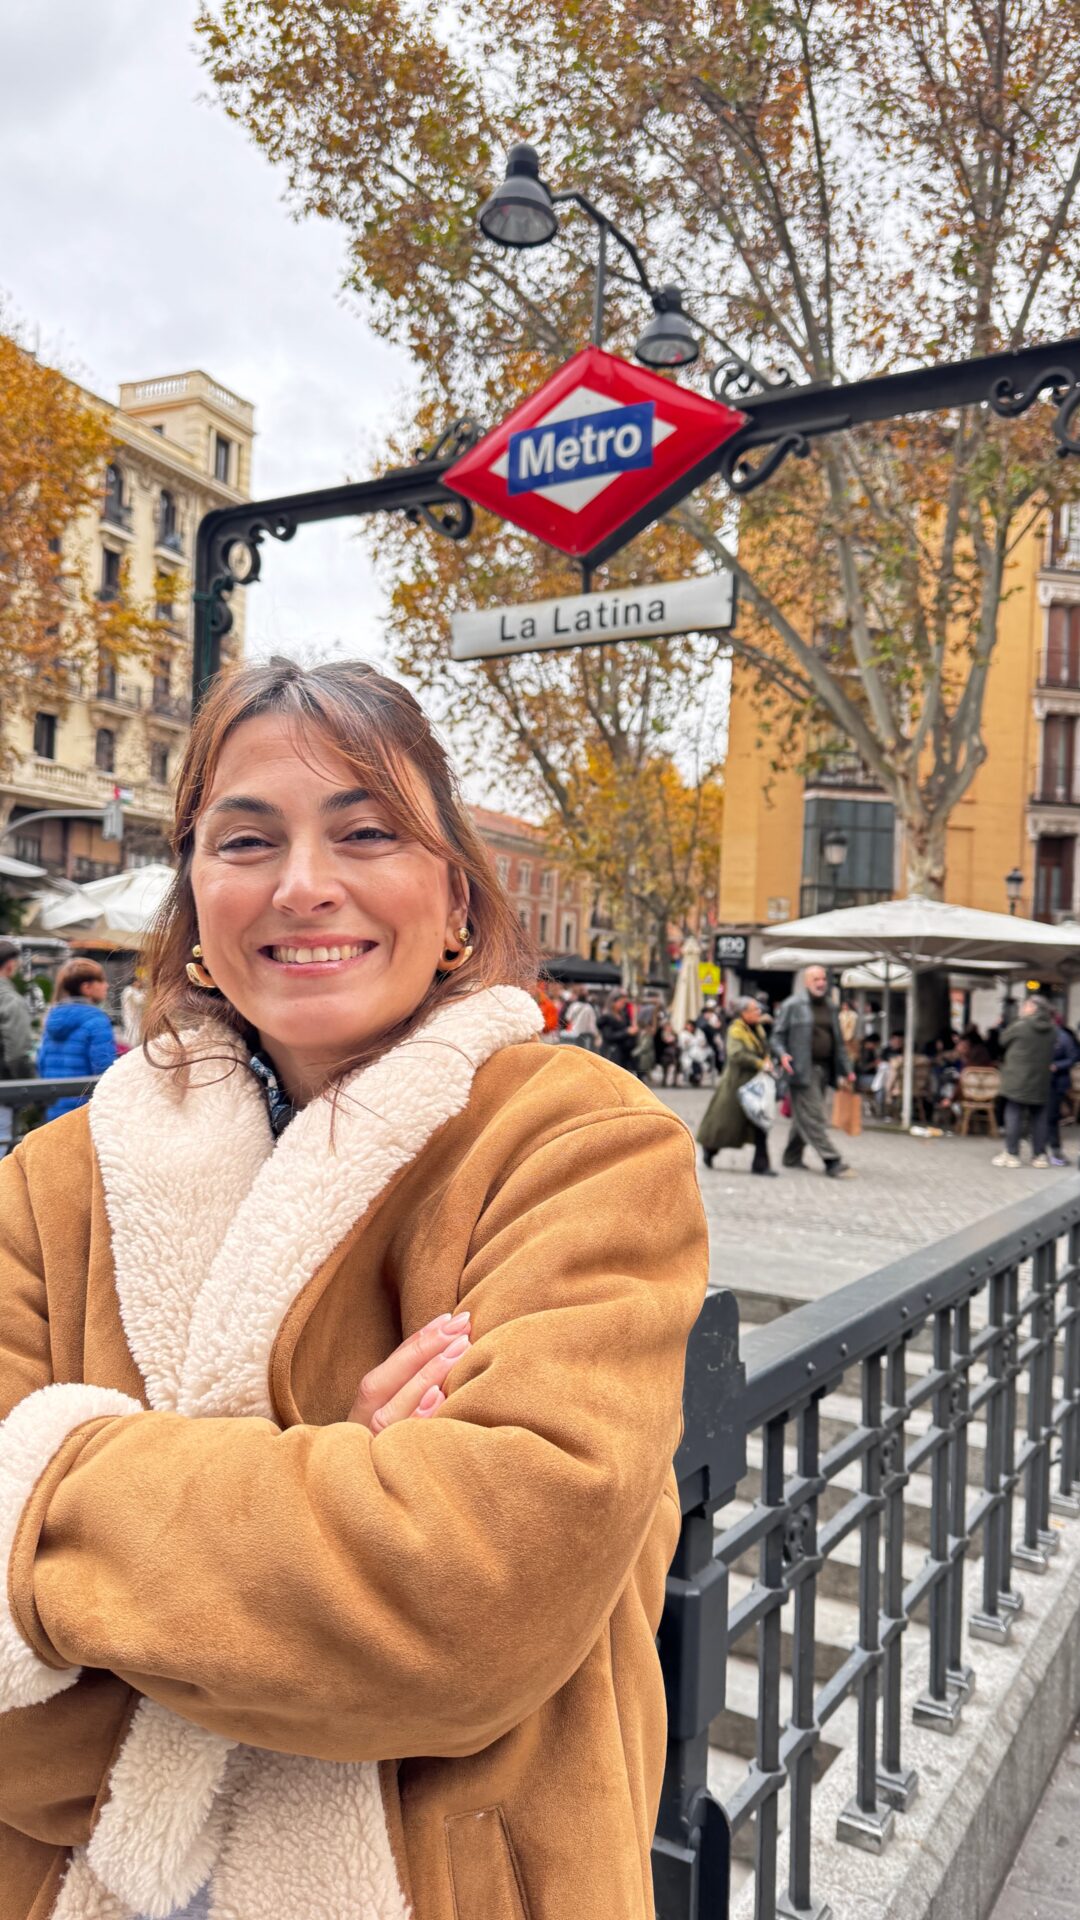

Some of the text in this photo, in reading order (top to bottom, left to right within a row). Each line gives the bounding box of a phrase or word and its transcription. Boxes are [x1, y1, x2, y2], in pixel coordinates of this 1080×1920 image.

[518, 423, 643, 480] Metro
[500, 598, 665, 642] La Latina
